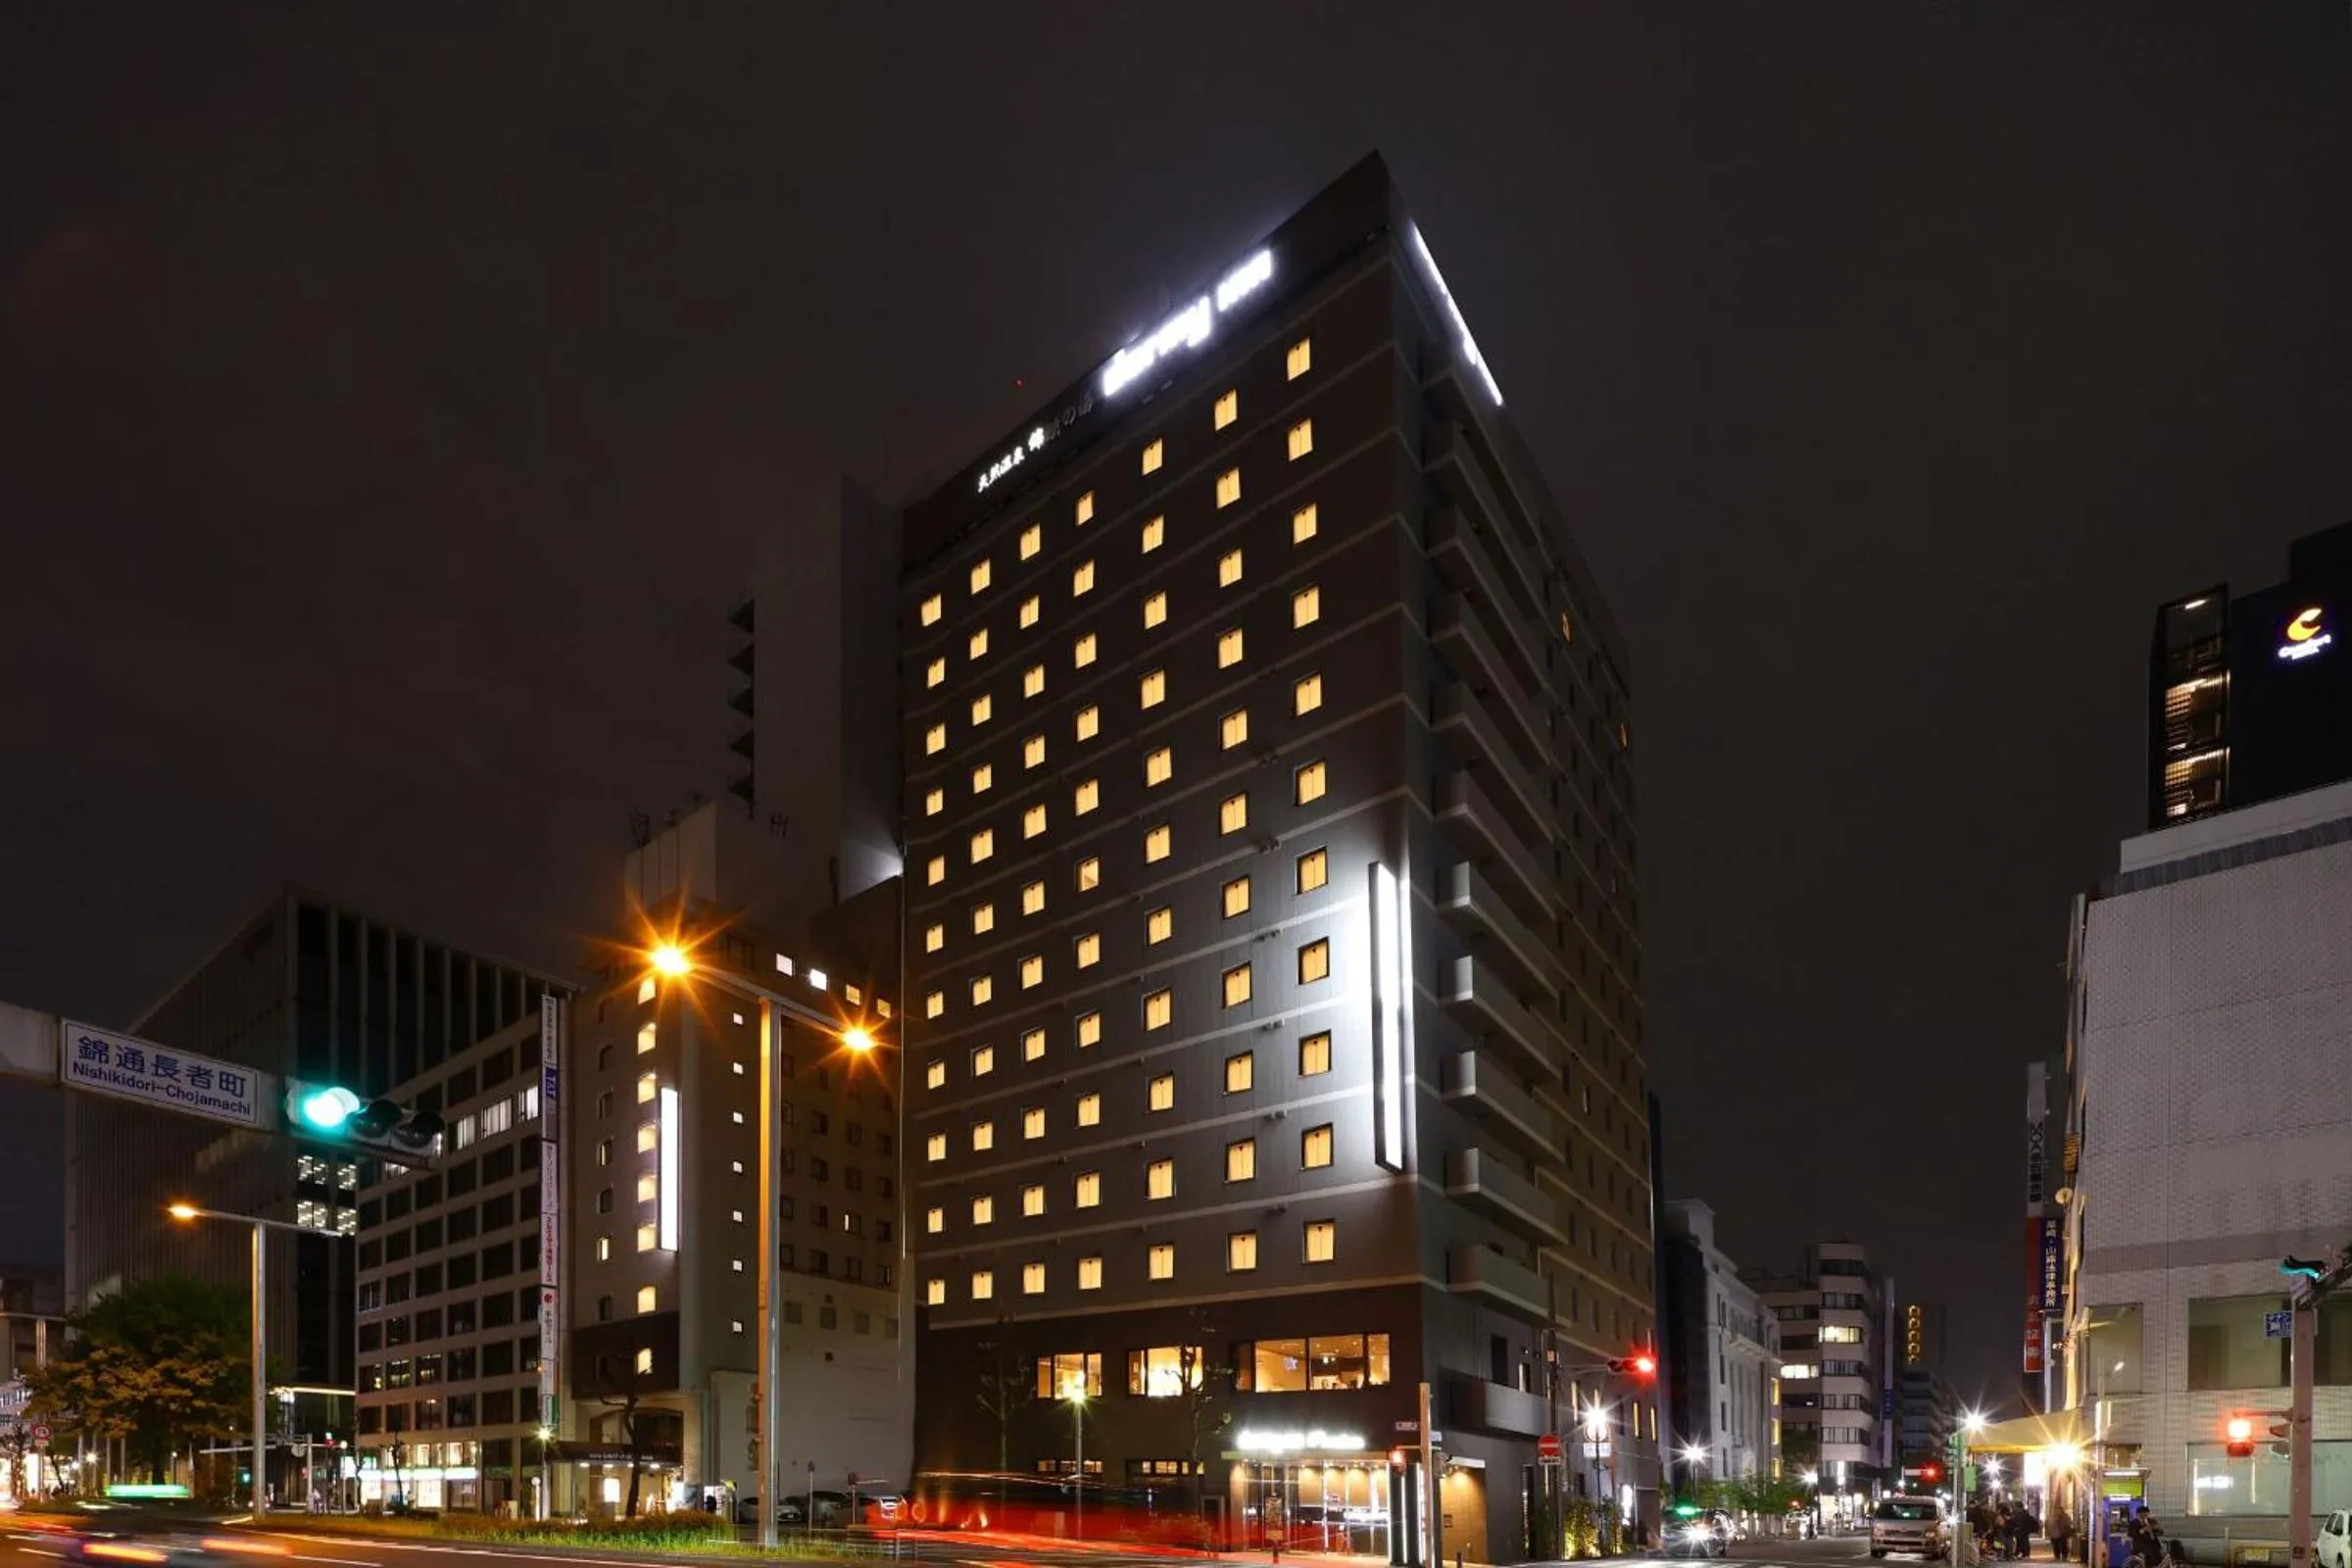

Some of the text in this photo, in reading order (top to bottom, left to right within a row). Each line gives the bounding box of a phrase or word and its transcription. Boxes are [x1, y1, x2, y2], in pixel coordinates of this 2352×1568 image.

[73, 1061, 251, 1115] Nishikidori-Chojamachi
[77, 1035, 247, 1099] 錦通長者町
